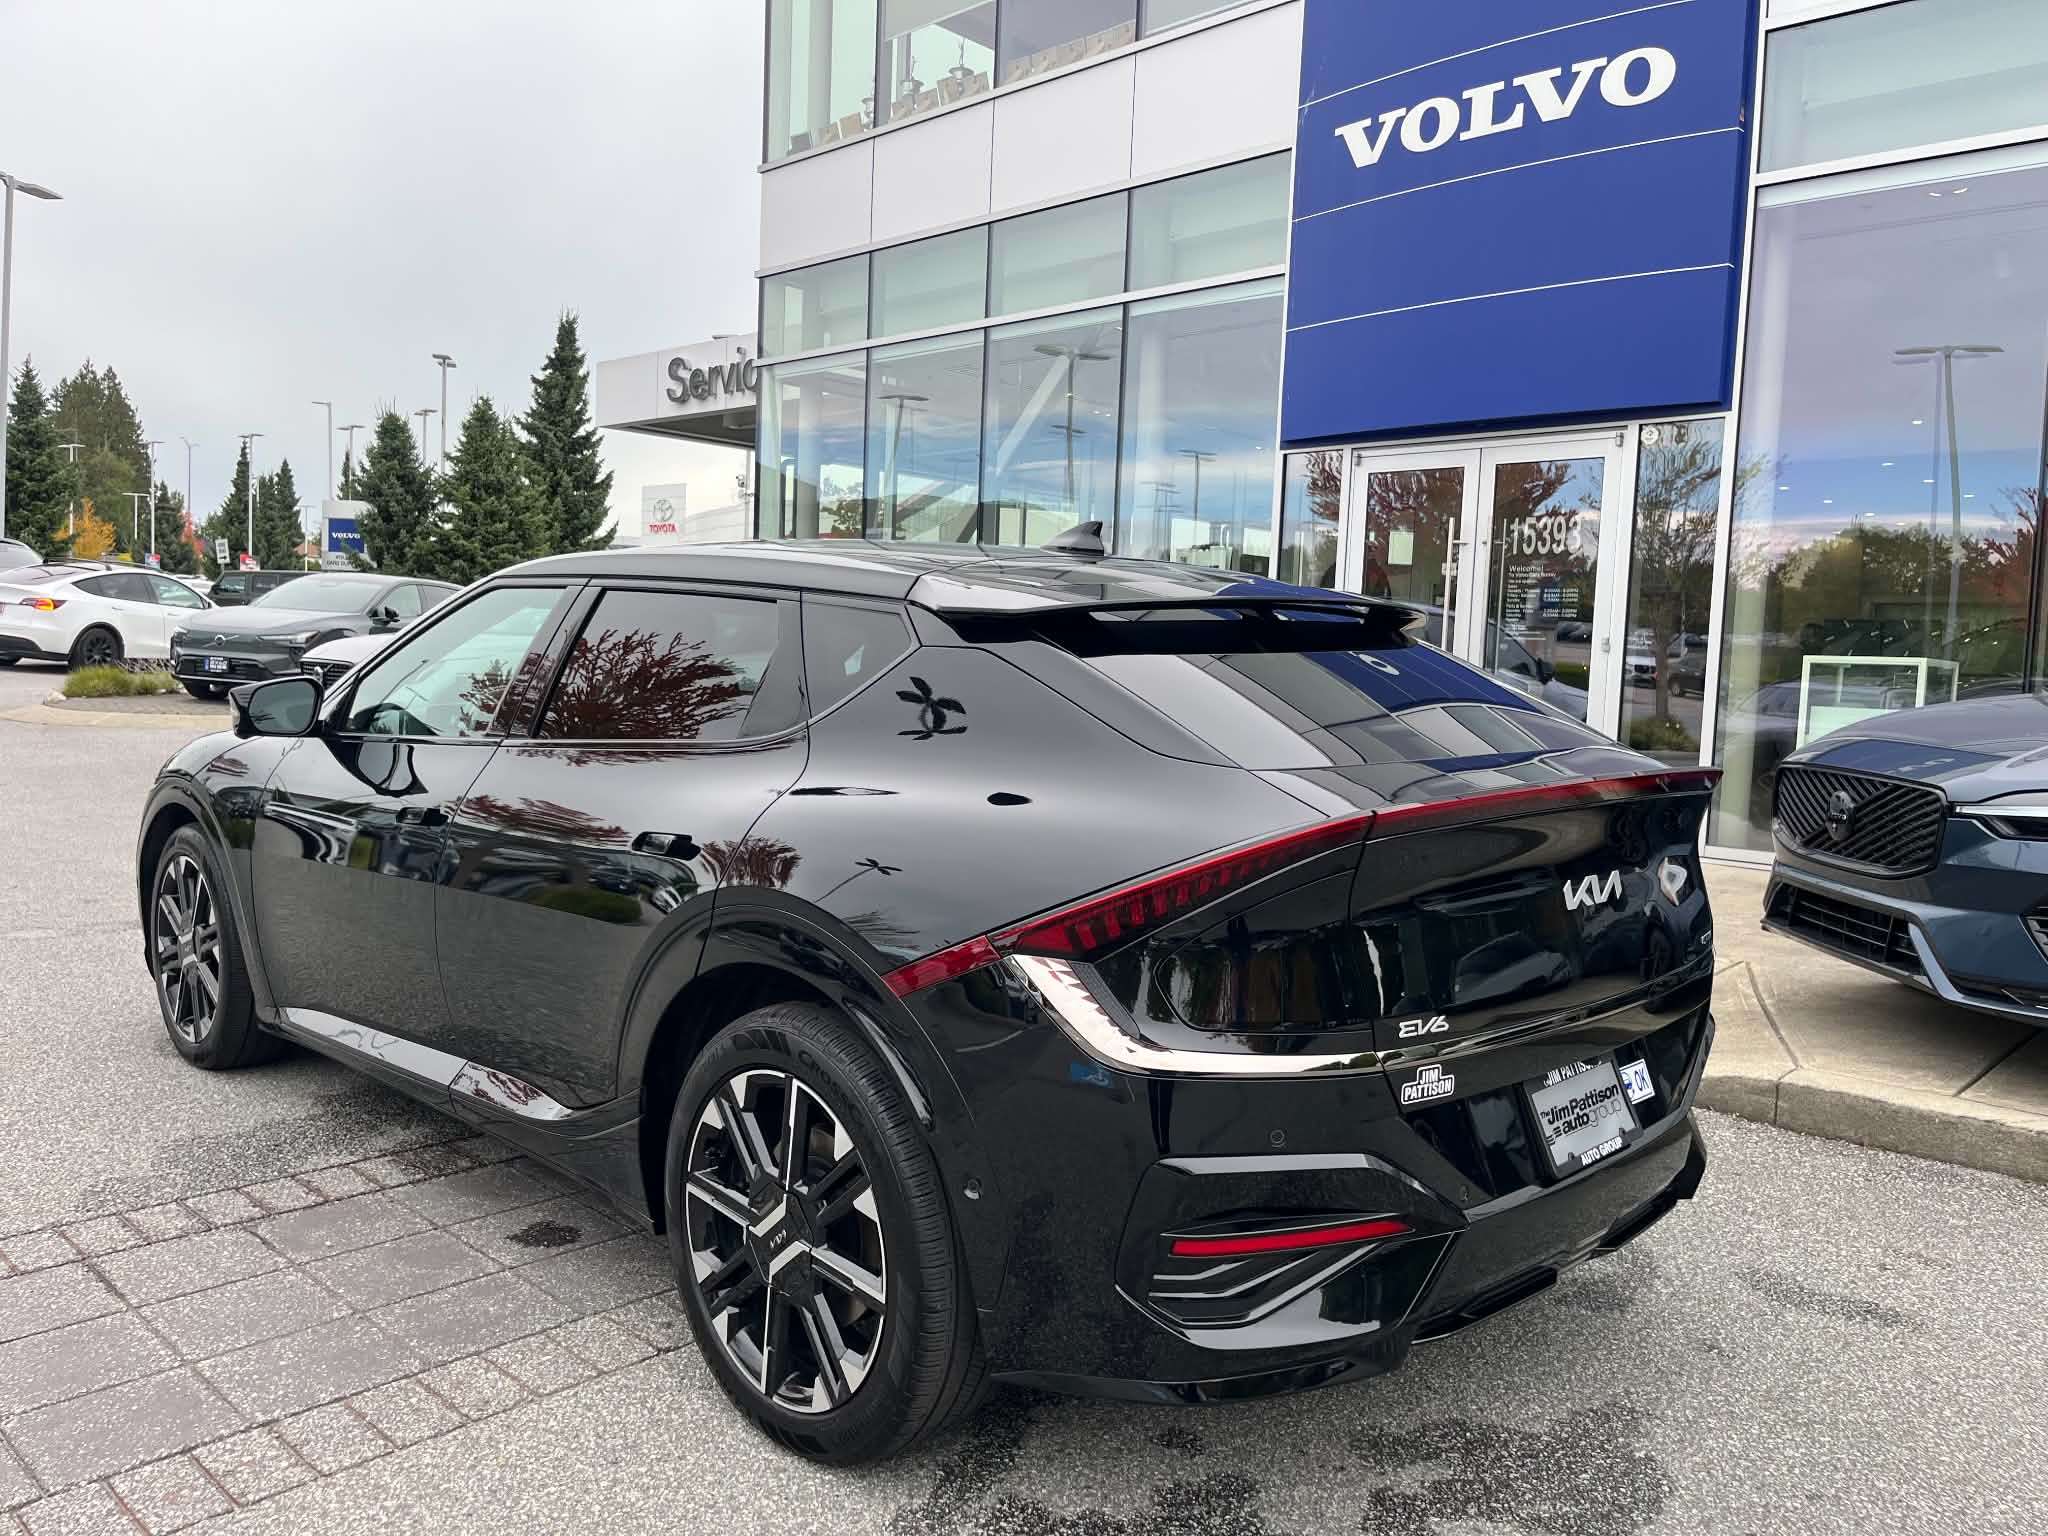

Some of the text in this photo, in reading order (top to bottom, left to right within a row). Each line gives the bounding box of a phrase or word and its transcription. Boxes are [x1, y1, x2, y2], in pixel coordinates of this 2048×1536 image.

[1334, 47, 1677, 169] VOLVO
[649, 523, 677, 534] TOYOTA
[1510, 515, 1581, 555] 15393
[1562, 869, 1623, 911] KIA
[1399, 1015, 1450, 1039] EV6
[1404, 1078, 1452, 1101] PATTISON
[1419, 1068, 1439, 1085] JIM
[1580, 1136, 1623, 1166] AUTO GROUP
